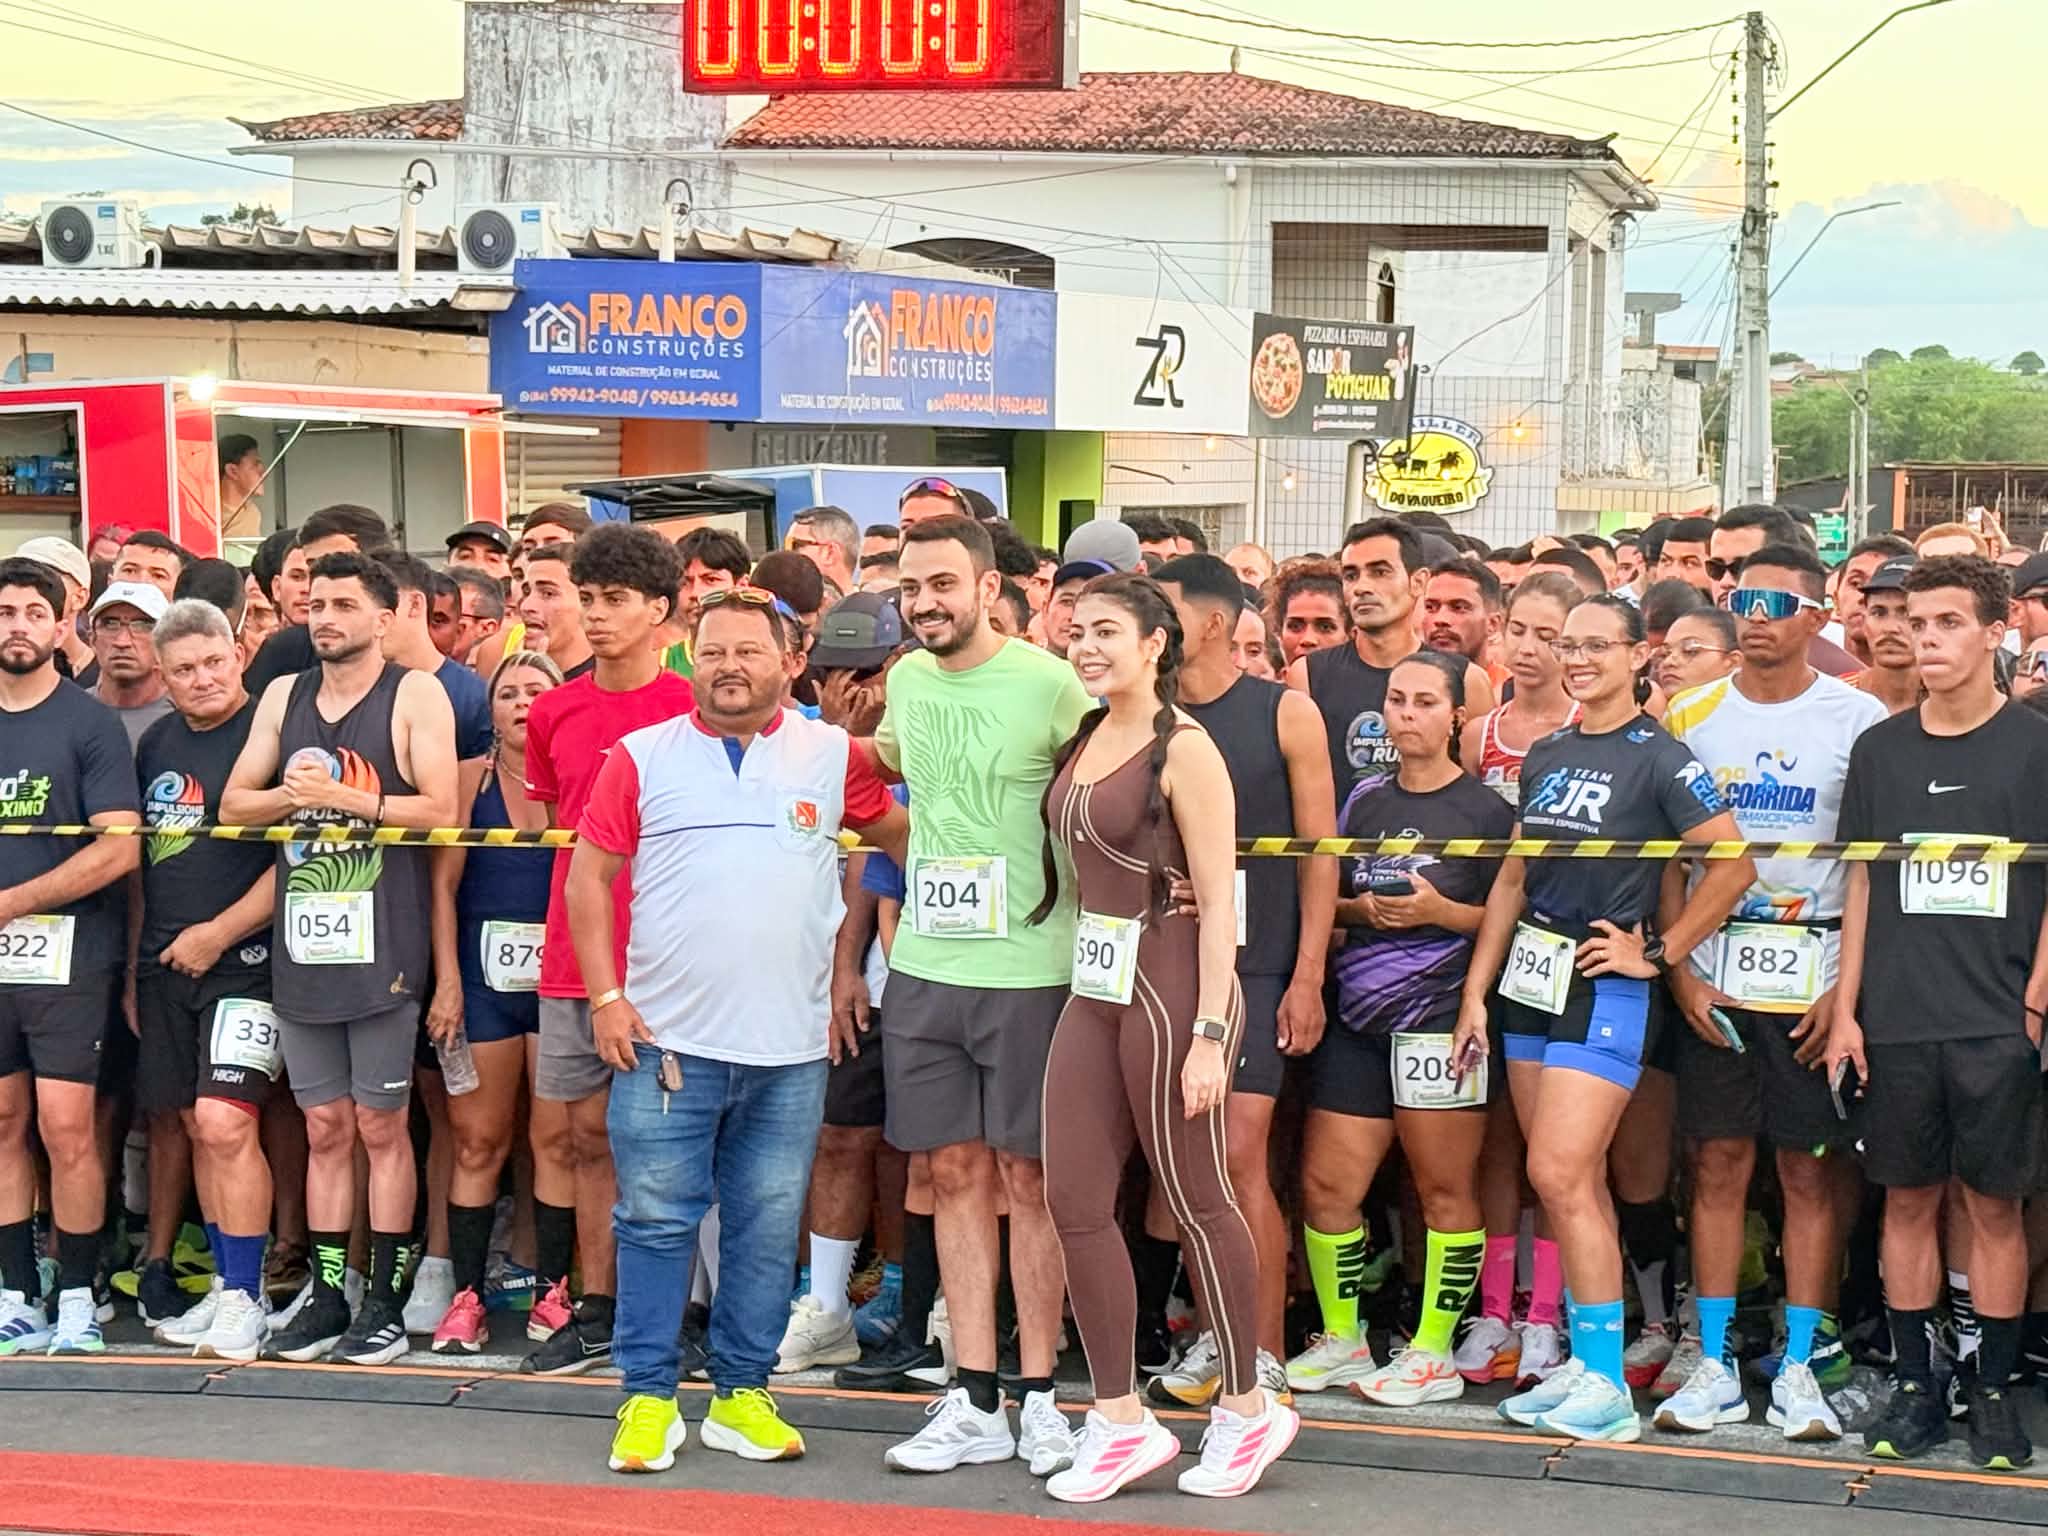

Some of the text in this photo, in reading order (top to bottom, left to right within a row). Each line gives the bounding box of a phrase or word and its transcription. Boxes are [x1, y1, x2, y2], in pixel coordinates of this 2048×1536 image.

[589, 293, 748, 341] FRANCO
[891, 289, 994, 357] FRANCO
[588, 338, 745, 361] CONSTRUÇÕES
[1306, 347, 1351, 375] SABOR
[547, 365, 592, 377] MATERIAL
[595, 366, 608, 377] DE
[610, 365, 671, 380] CONSTRUÇÃO
[889, 356, 992, 386] CONSTRUÇÕES
[1325, 374, 1390, 400] POTIGUAR
[1390, 492, 1464, 507] DO VAQUEIRO
[1574, 768, 1614, 784] TEAM
[1547, 779, 1611, 823] JR
[1725, 782, 1816, 813] CORRIDA
[1914, 860, 1990, 886] 1096
[924, 880, 981, 908] 204
[298, 913, 353, 938] 054
[1514, 946, 1553, 982] 994
[1738, 946, 1799, 976] 882
[235, 1019, 280, 1051] 331
[211, 1069, 246, 1085] HIGH
[316, 1244, 346, 1291] RUN
[1435, 1243, 1484, 1312] RUN
